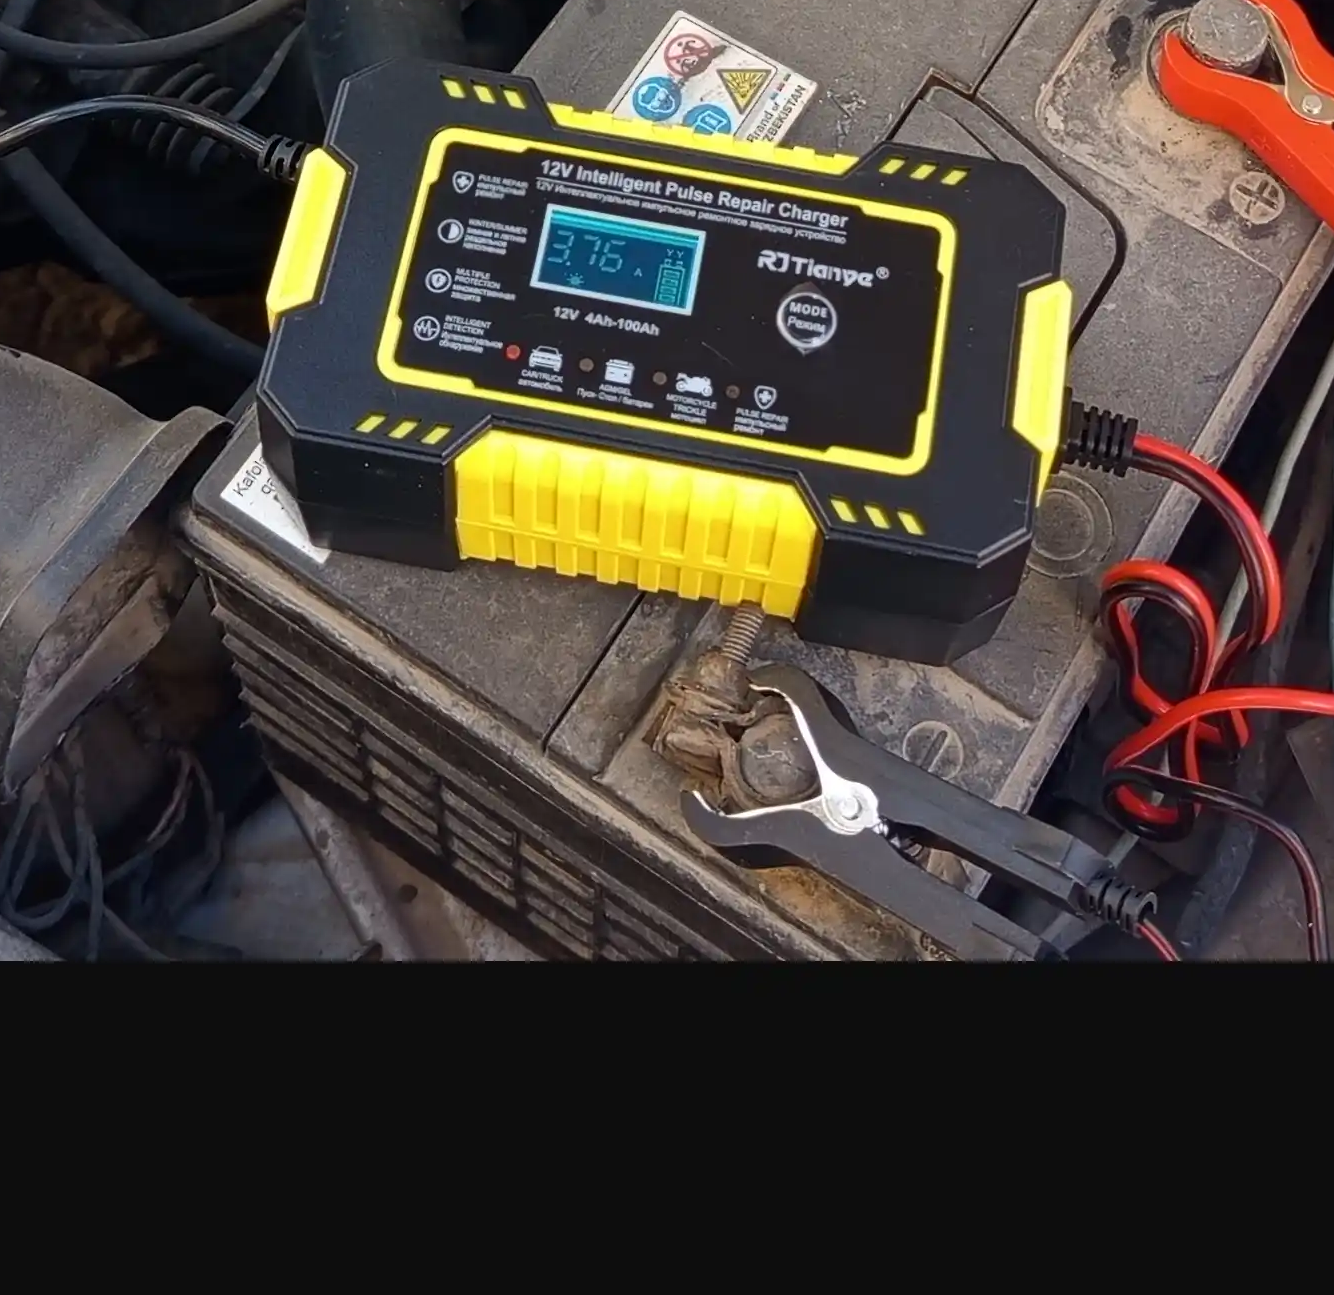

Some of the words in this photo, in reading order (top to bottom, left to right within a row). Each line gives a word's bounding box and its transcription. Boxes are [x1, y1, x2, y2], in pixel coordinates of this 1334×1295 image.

[745, 108, 775, 145] Brand
[769, 100, 781, 112] of
[534, 179, 554, 191] 12V
[539, 159, 574, 179] 12V
[574, 165, 663, 199] Intelligent
[664, 181, 715, 205] Pulse
[715, 191, 775, 219] Repair
[776, 201, 850, 233] Charger
[788, 300, 829, 319] MODE
[442, 321, 485, 336] DETECTION
[553, 305, 580, 321] 12V
[583, 311, 661, 337] 4Ah-100Ah
[785, 315, 827, 335] Режим
[520, 368, 564, 384] CAR/TRUCK
[673, 403, 708, 417] TRICKLE
